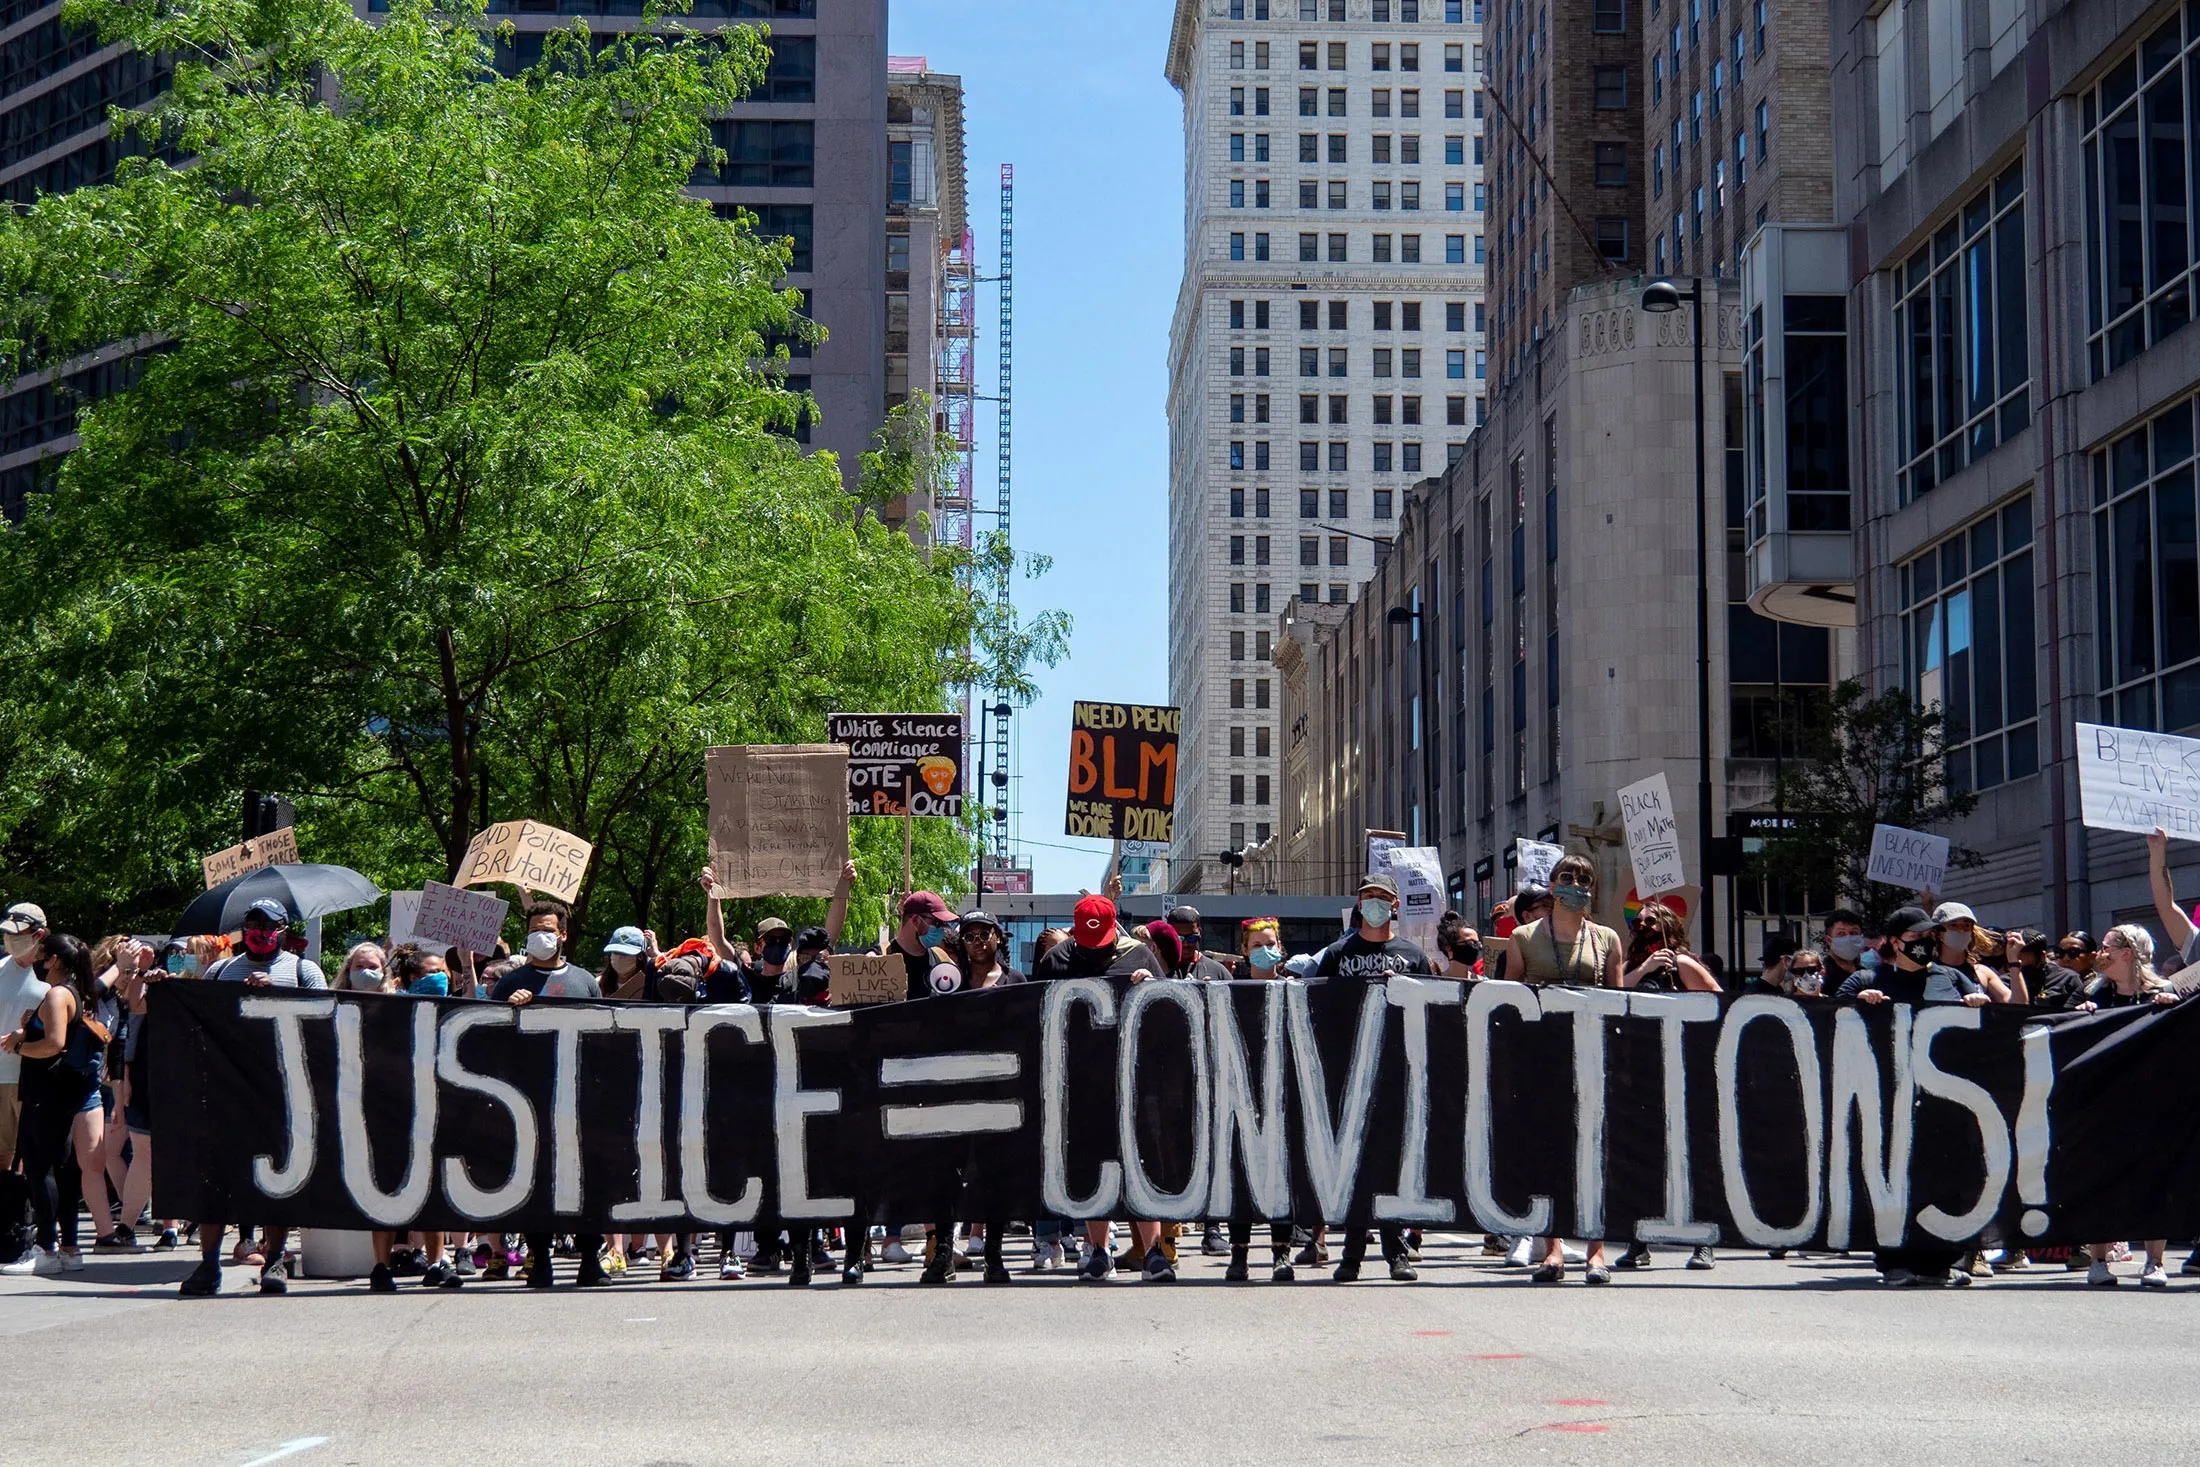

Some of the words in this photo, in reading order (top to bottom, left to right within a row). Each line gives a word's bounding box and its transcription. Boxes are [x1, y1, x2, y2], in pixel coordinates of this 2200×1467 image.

[1075, 703, 1127, 729] NEED
[2096, 729, 2200, 779] BLACK
[765, 765, 796, 785] NOT
[1070, 729, 1177, 805] BLM
[2117, 761, 2199, 803] LIVES
[1069, 799, 1088, 813] WE
[1090, 801, 1113, 818] ARE
[1622, 790, 1662, 823] BLACK
[2105, 795, 2200, 833] MATTER
[720, 819, 731, 833] A
[1069, 813, 1114, 838] DONE
[208, 854, 238, 879] SOME
[258, 832, 291, 854] THOSE
[470, 825, 511, 855] END
[517, 822, 585, 868] Police
[1885, 833, 1934, 861] BLACK
[1871, 854, 1905, 878] LIVES
[427, 883, 439, 895] I
[444, 887, 471, 904] SEE
[477, 896, 500, 914] YOU
[1164, 895, 1176, 904] ONE
[419, 914, 429, 925] I
[423, 898, 436, 911] I
[441, 903, 478, 923] HEAR
[481, 913, 501, 932] YOU
[1086, 918, 1100, 929] C
[423, 928, 460, 946] WITH
[461, 939, 488, 953] YOU
[841, 959, 888, 976] BLACK
[857, 977, 899, 991] LIVES
[840, 990, 897, 1004] MATTER
[238, 997, 856, 1230] JUSTICE
[880, 1051, 1024, 1139] =
[1040, 975, 2054, 1250] CONVICTIONS!
